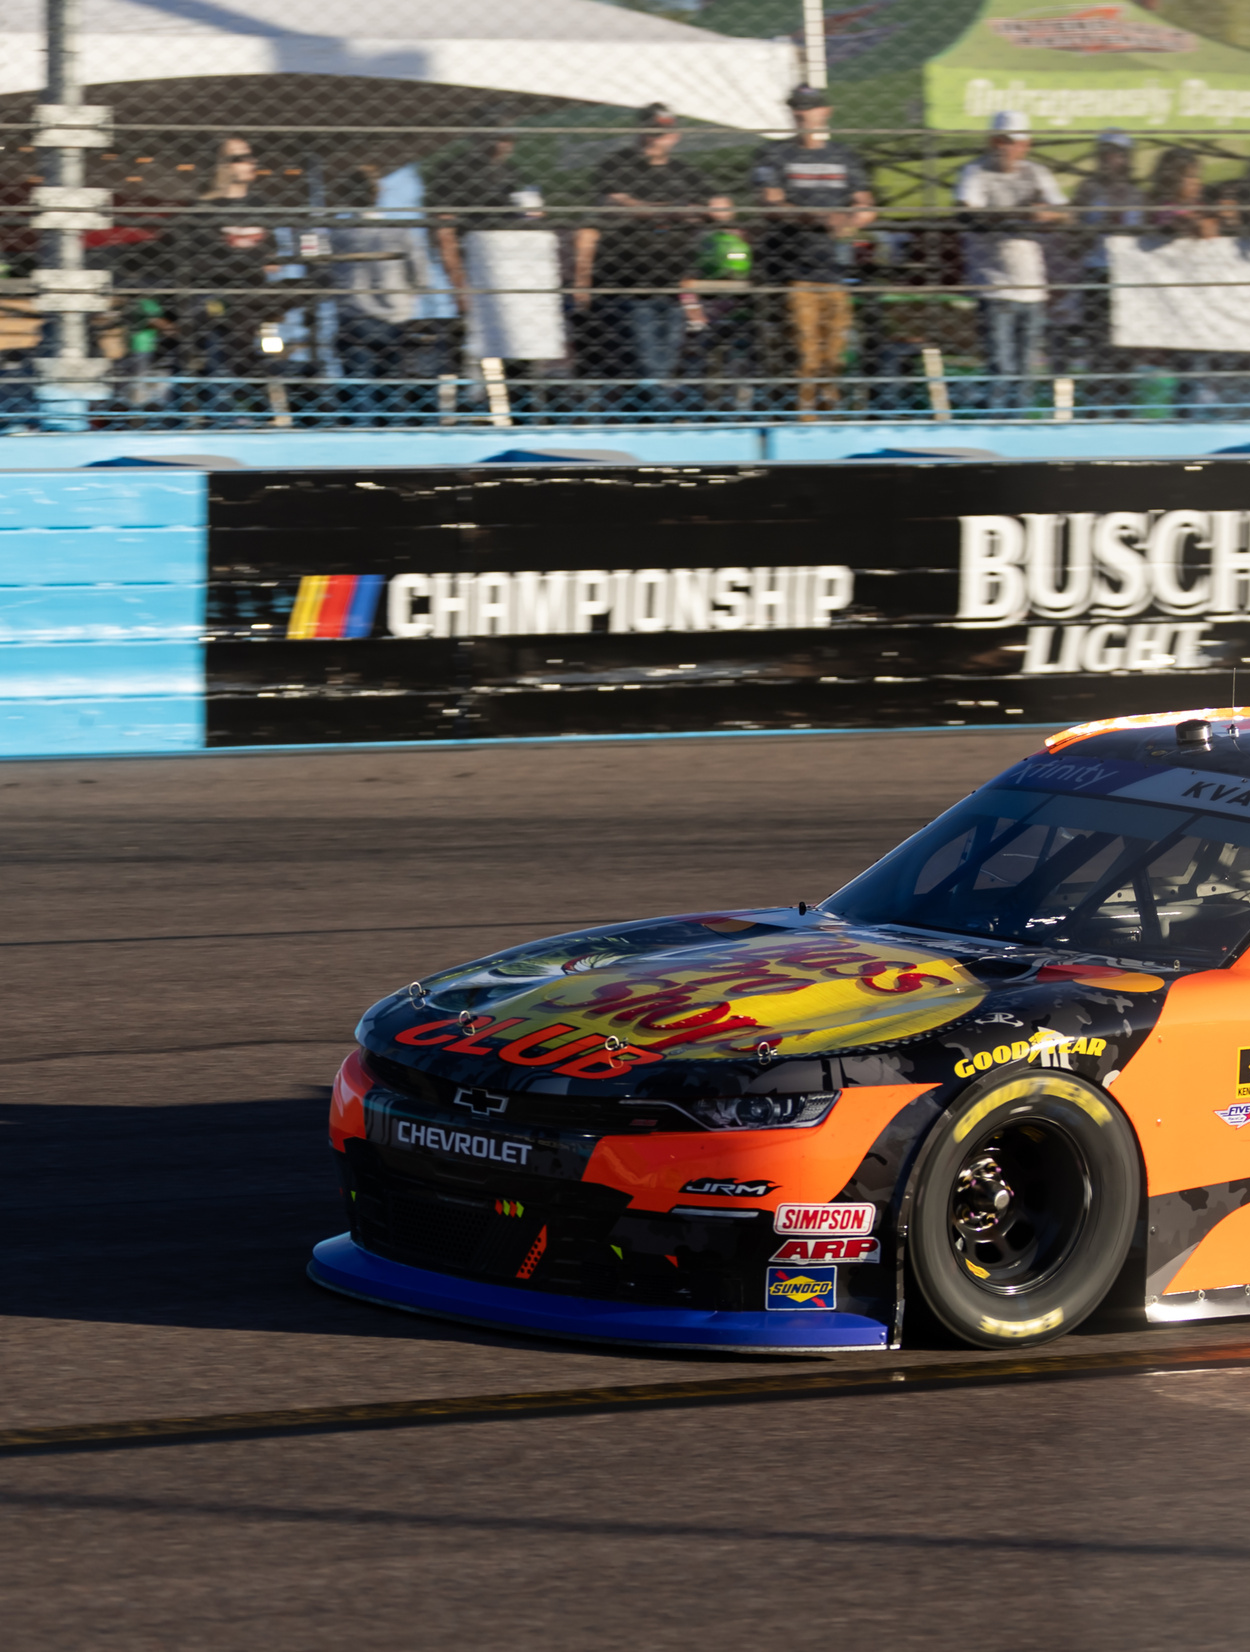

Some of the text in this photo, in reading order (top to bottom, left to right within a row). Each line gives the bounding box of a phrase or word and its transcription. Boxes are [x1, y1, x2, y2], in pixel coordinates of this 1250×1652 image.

[387, 565, 854, 639] CHAMPIONSHIP
[1021, 622, 1213, 674] LIGHT
[1009, 759, 1120, 791] xfinity
[394, 1015, 665, 1080] CLUB
[954, 1031, 1107, 1078] GOODYEAR
[397, 1120, 533, 1166] CHEVROLET
[686, 1182, 767, 1197] JRM
[782, 1208, 866, 1230] SIMPSON
[774, 1239, 879, 1259] ARP
[772, 1282, 830, 1294] SUNOCO
